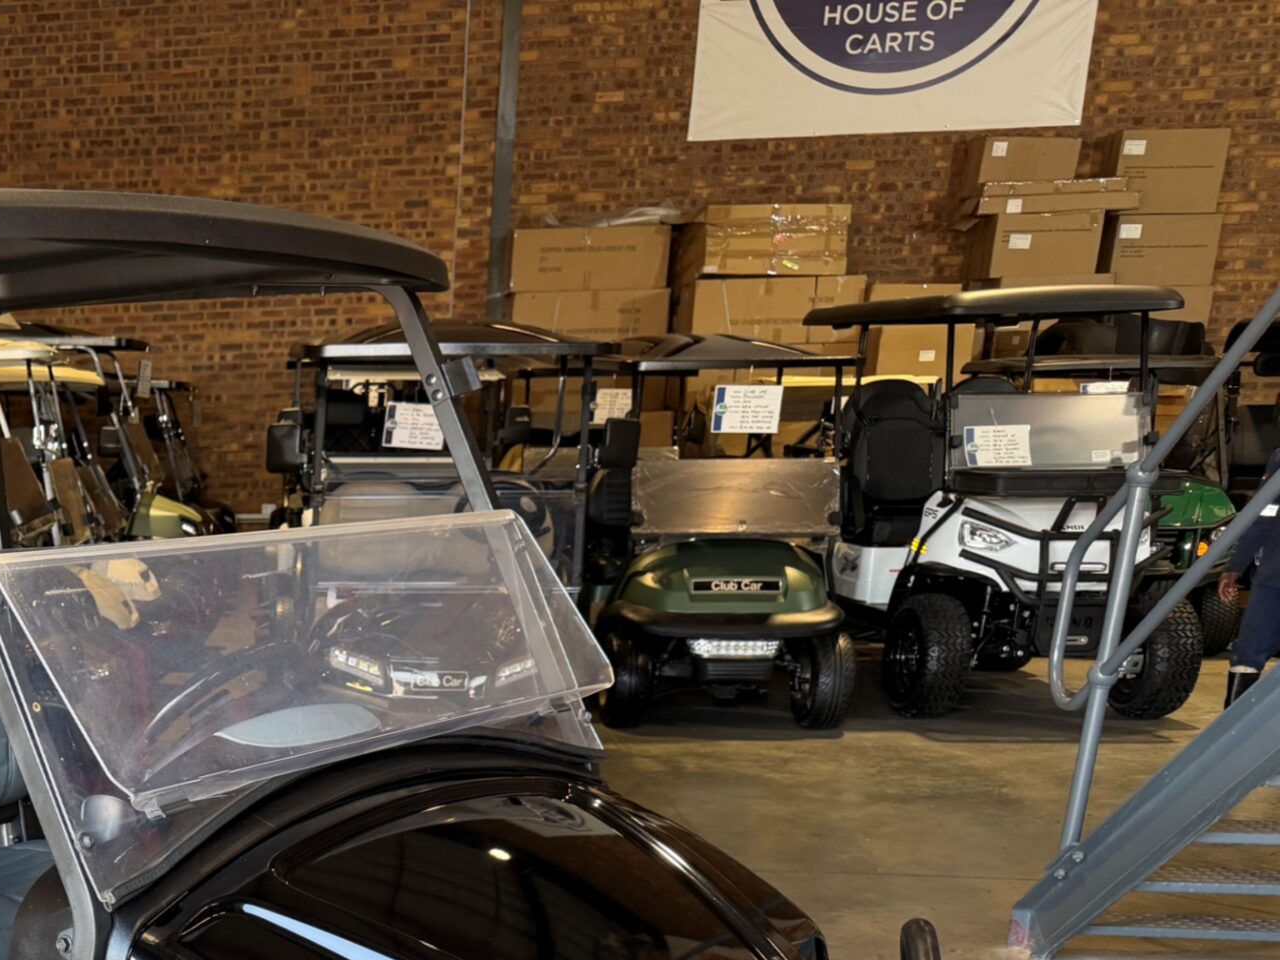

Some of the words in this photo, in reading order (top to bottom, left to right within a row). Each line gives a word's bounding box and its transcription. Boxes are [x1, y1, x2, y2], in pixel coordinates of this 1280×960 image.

[823, 3, 916, 26] HOUSE
[926, 0, 965, 21] OF
[845, 31, 935, 55] CARTS
[710, 580, 738, 591] Club
[741, 580, 763, 591] Car
[443, 675, 462, 687] Car
